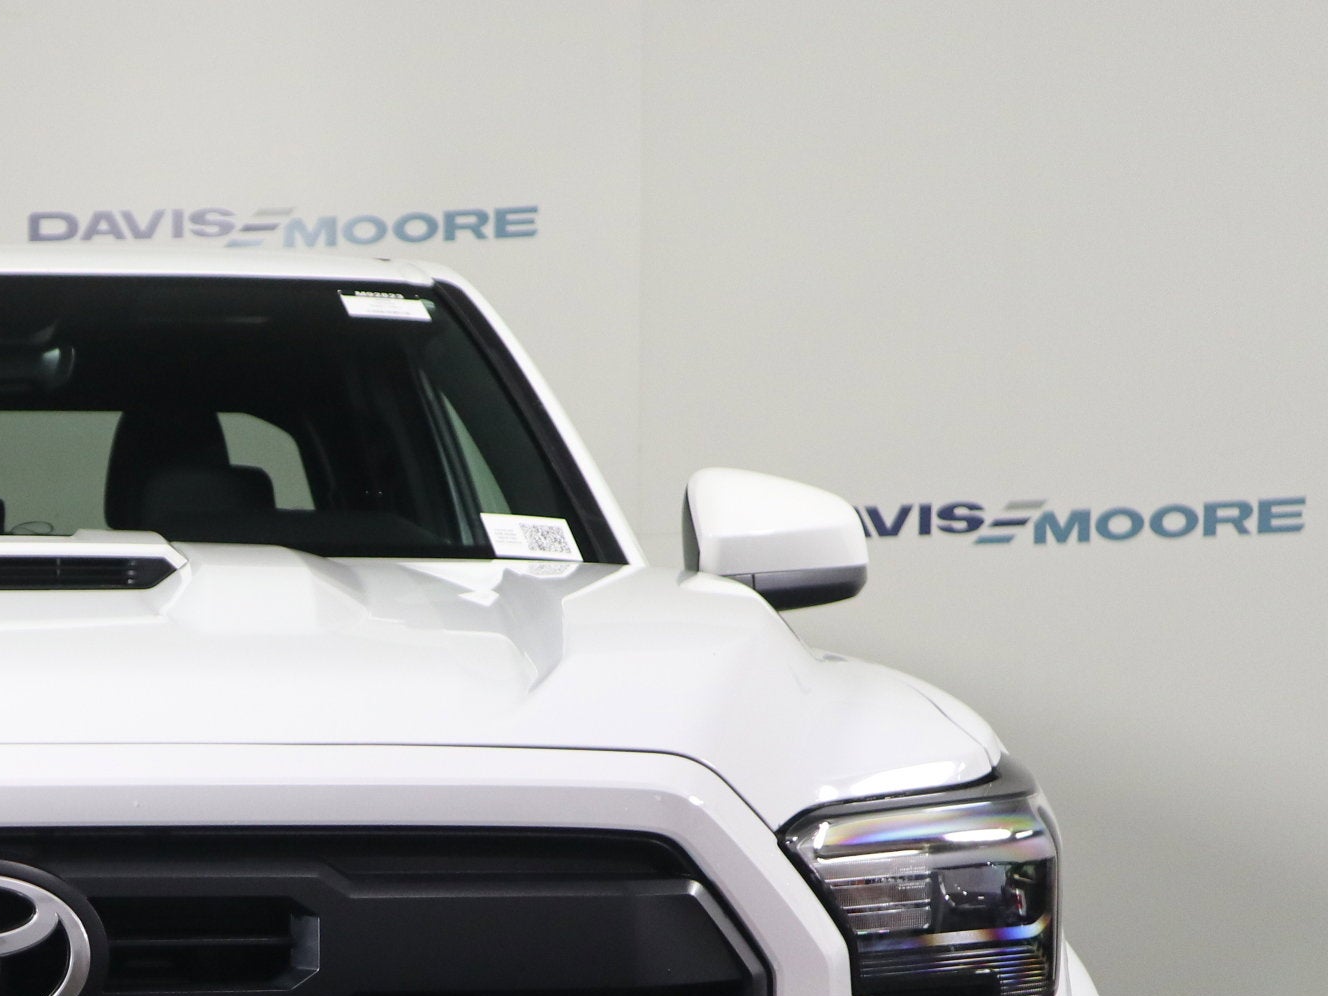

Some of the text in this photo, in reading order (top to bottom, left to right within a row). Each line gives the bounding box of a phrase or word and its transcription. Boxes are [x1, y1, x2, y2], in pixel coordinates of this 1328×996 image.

[27, 205, 539, 249] DAVIS MOORE
[853, 496, 1307, 545] VIS MOORE
